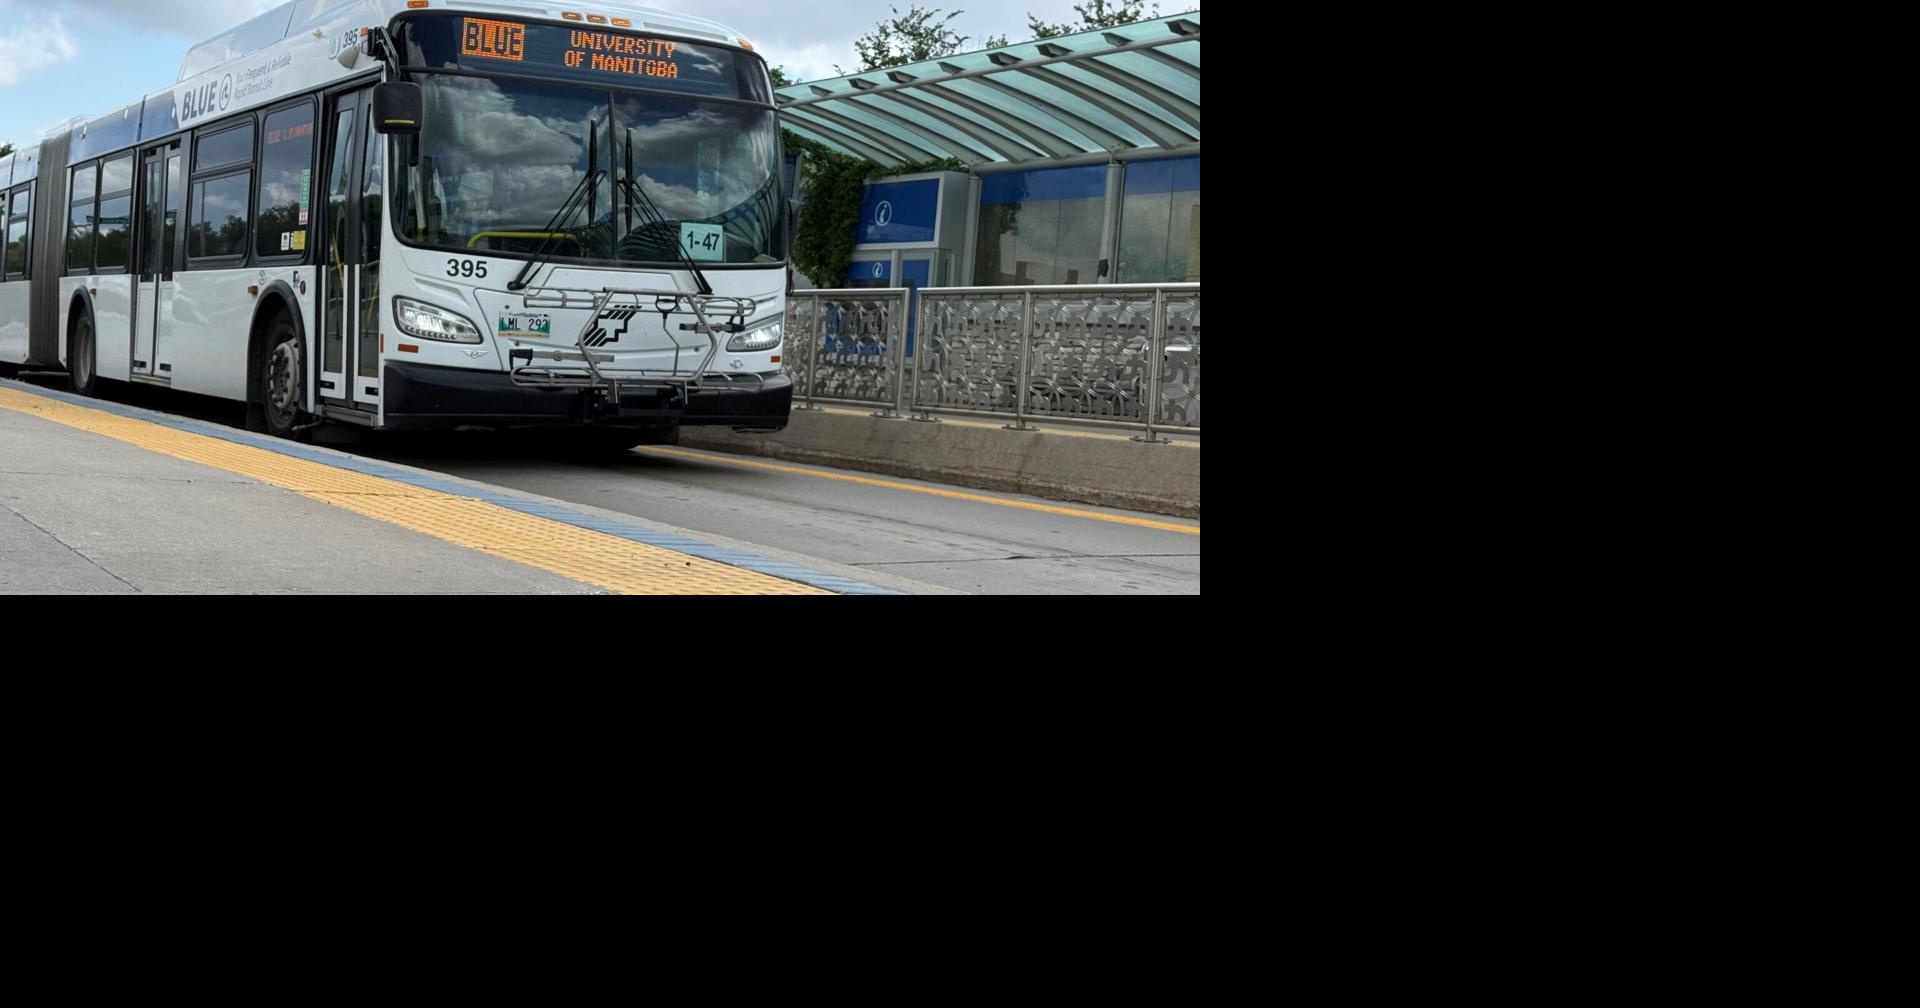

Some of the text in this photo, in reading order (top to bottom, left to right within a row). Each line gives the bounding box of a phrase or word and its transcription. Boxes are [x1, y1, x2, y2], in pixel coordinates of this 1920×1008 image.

[342, 28, 358, 48] 395
[465, 20, 523, 58] BLUE
[570, 30, 676, 58] UNIVERSITY
[564, 50, 679, 79] OF MANITOBA
[181, 80, 218, 122] BLUE
[687, 231, 720, 251] 1-47
[446, 258, 488, 279] 395
